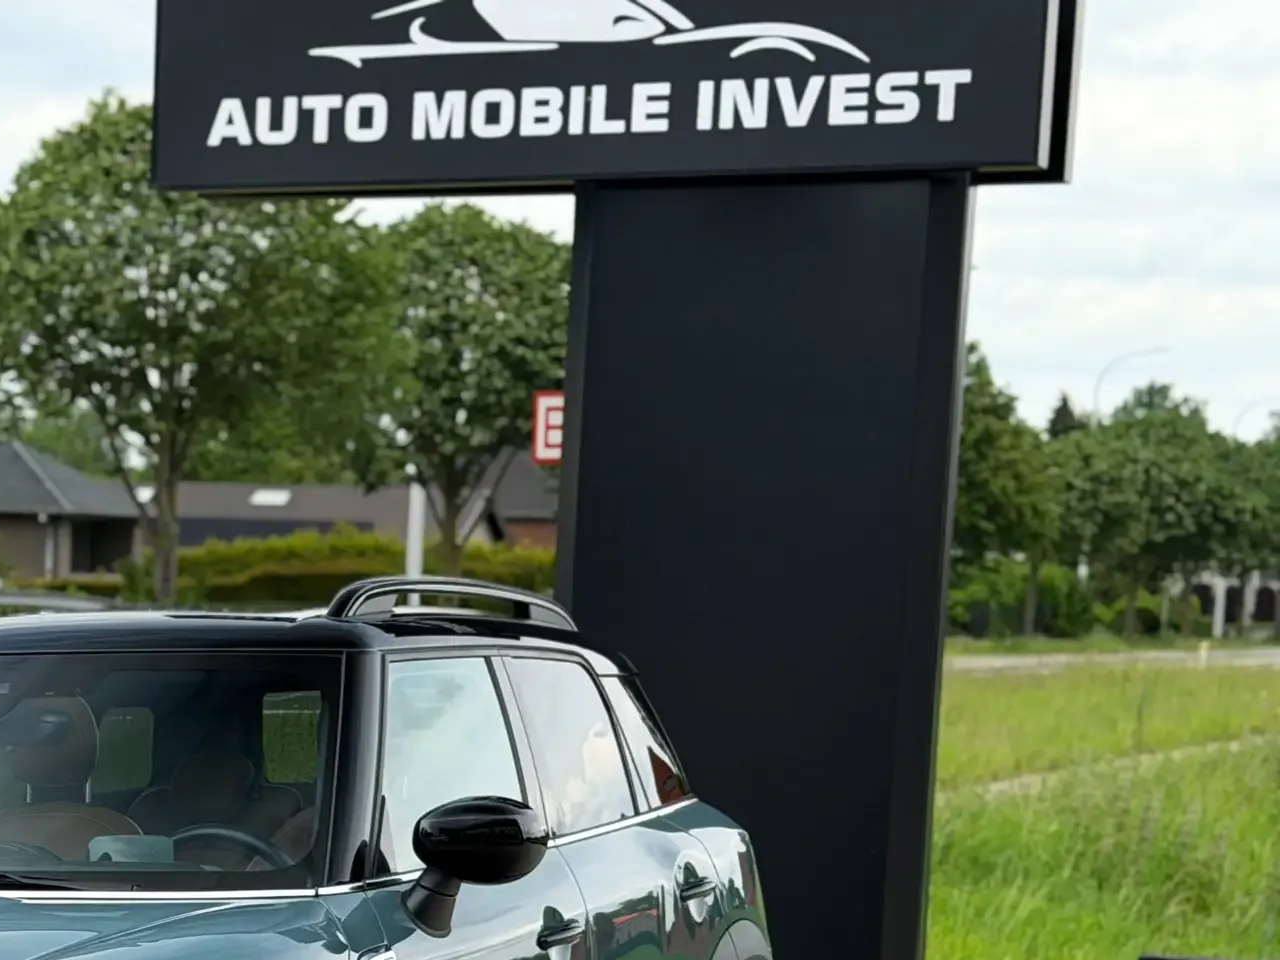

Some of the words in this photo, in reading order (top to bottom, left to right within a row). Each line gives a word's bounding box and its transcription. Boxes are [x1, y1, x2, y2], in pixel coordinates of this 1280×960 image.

[206, 93, 388, 147] AUTO
[411, 82, 672, 141] MOBILE
[696, 69, 972, 131] INVEST
